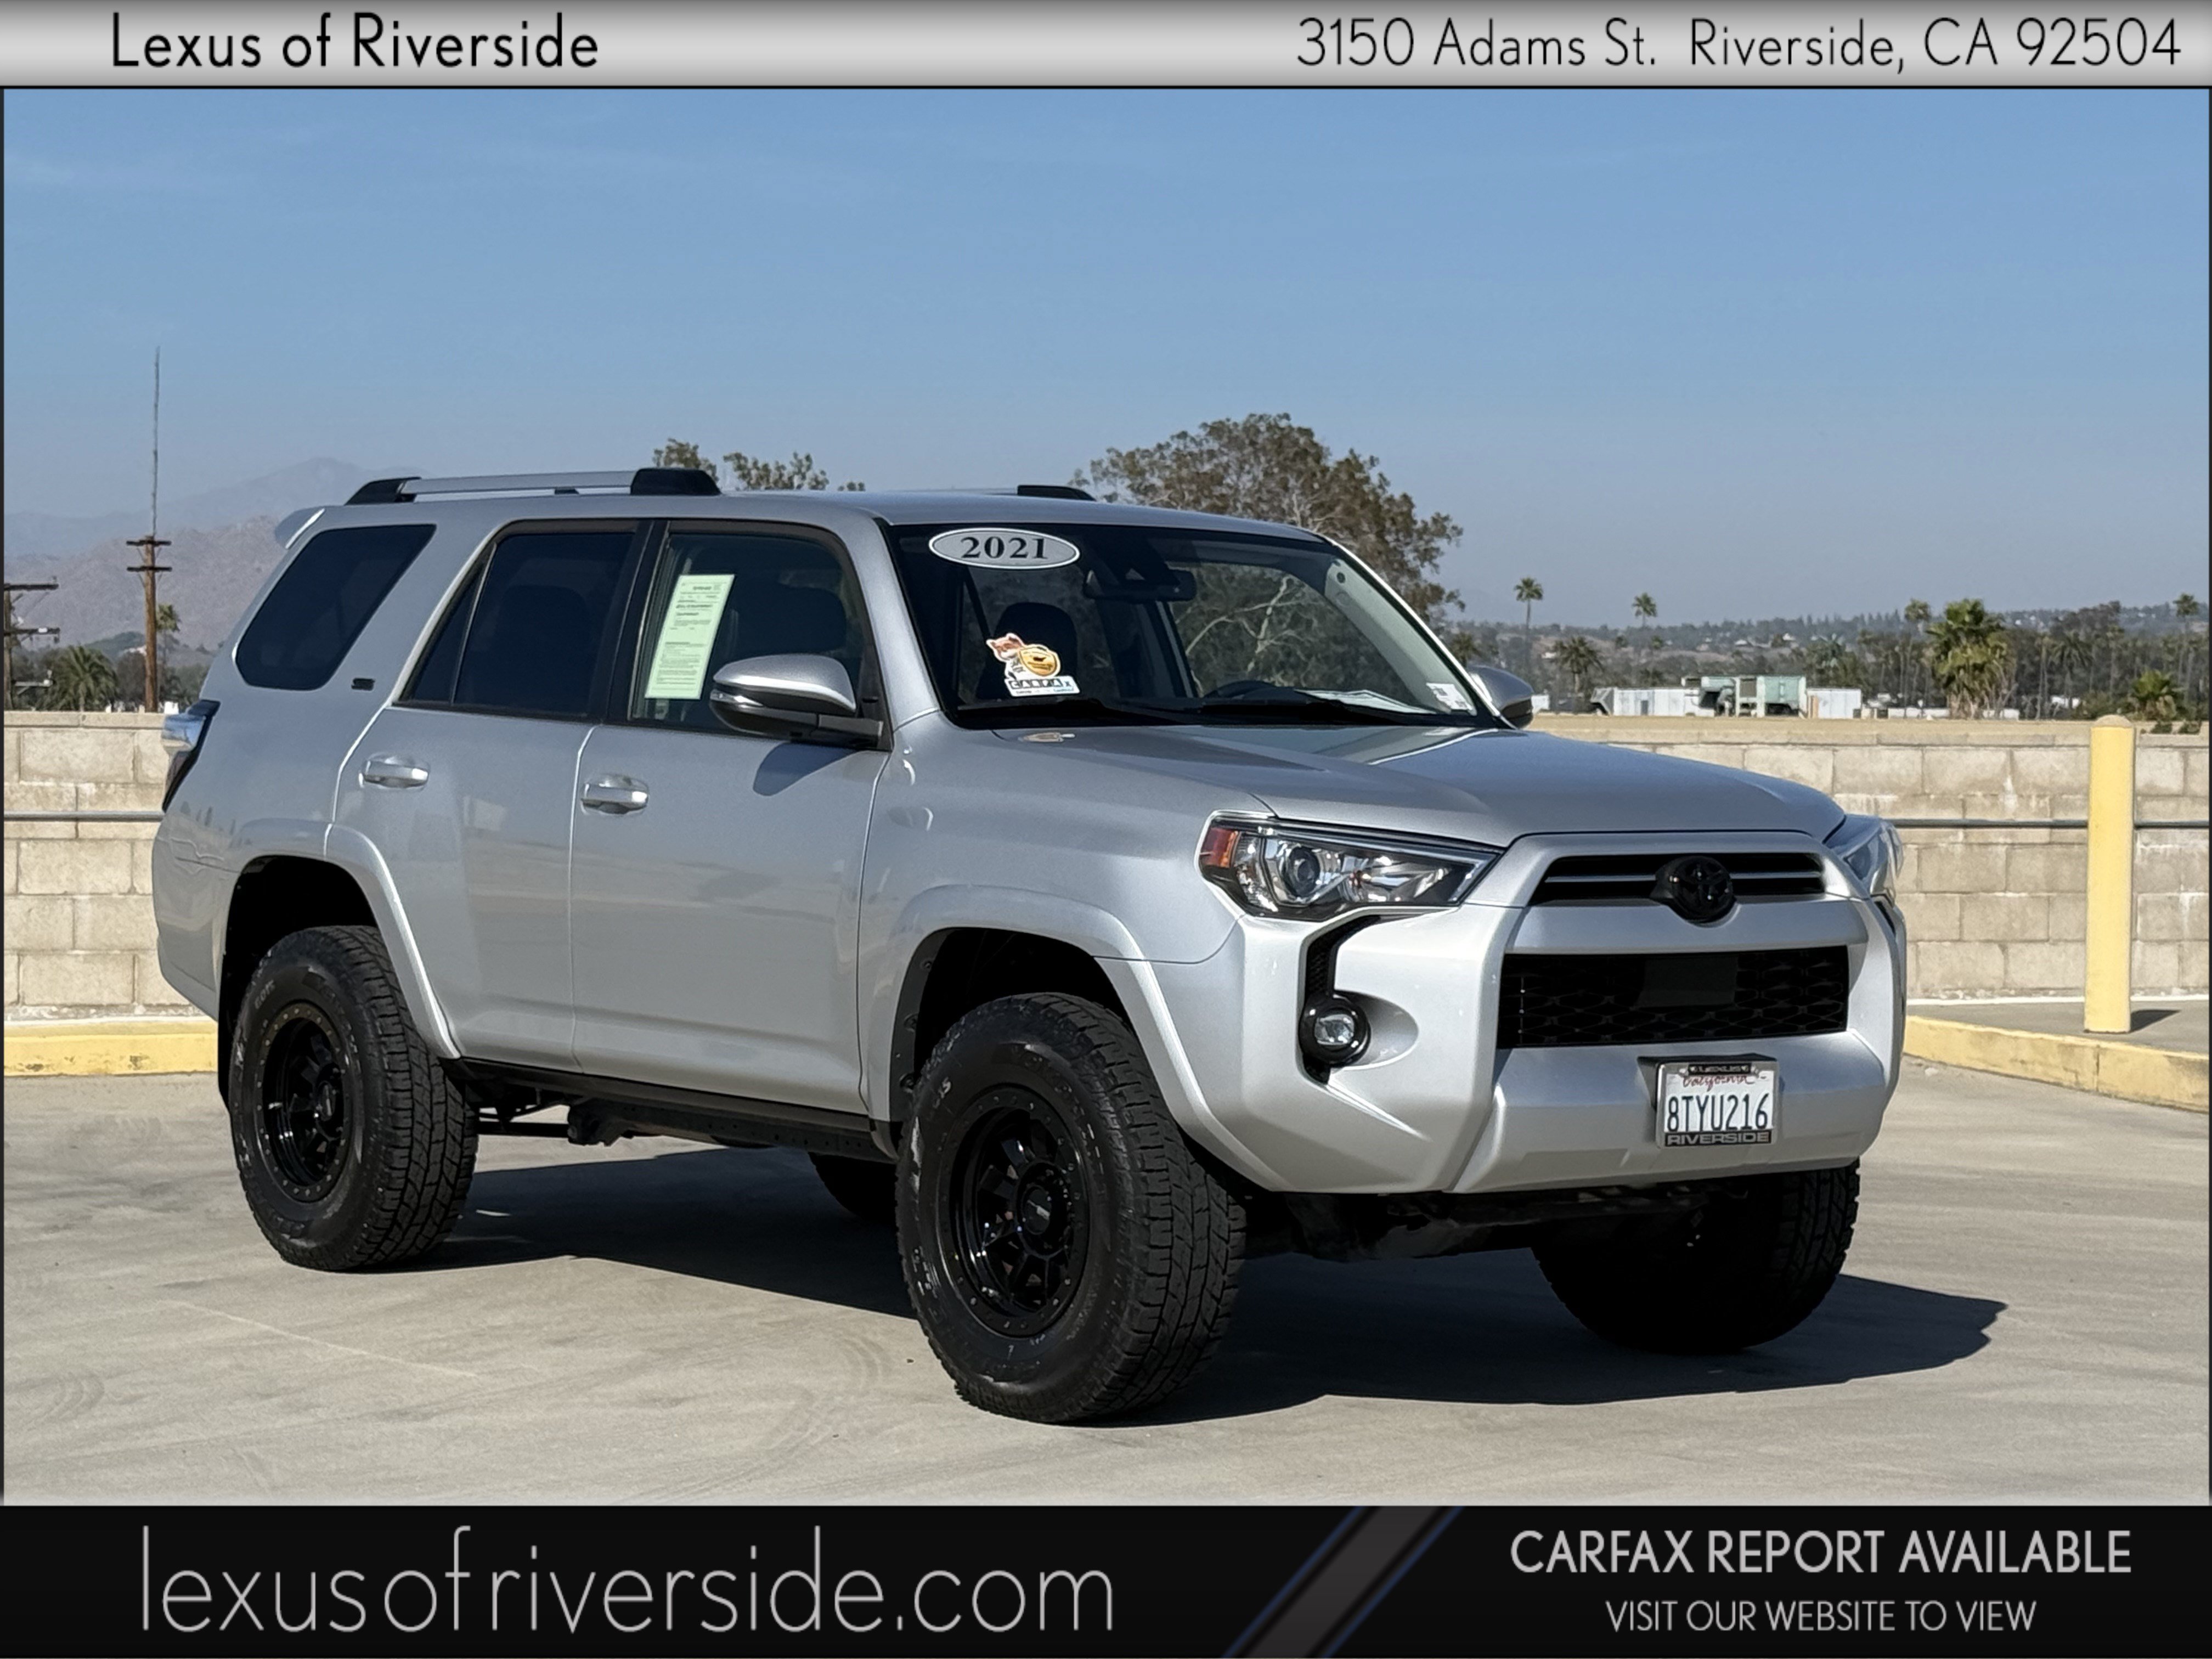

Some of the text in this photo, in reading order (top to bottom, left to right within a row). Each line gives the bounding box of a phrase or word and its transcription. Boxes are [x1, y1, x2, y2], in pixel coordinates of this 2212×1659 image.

[960, 536, 1048, 559] 2021
[1667, 1093, 1769, 1132] 8TYU216
[1667, 1132, 1769, 1145] RIVERSIDE
